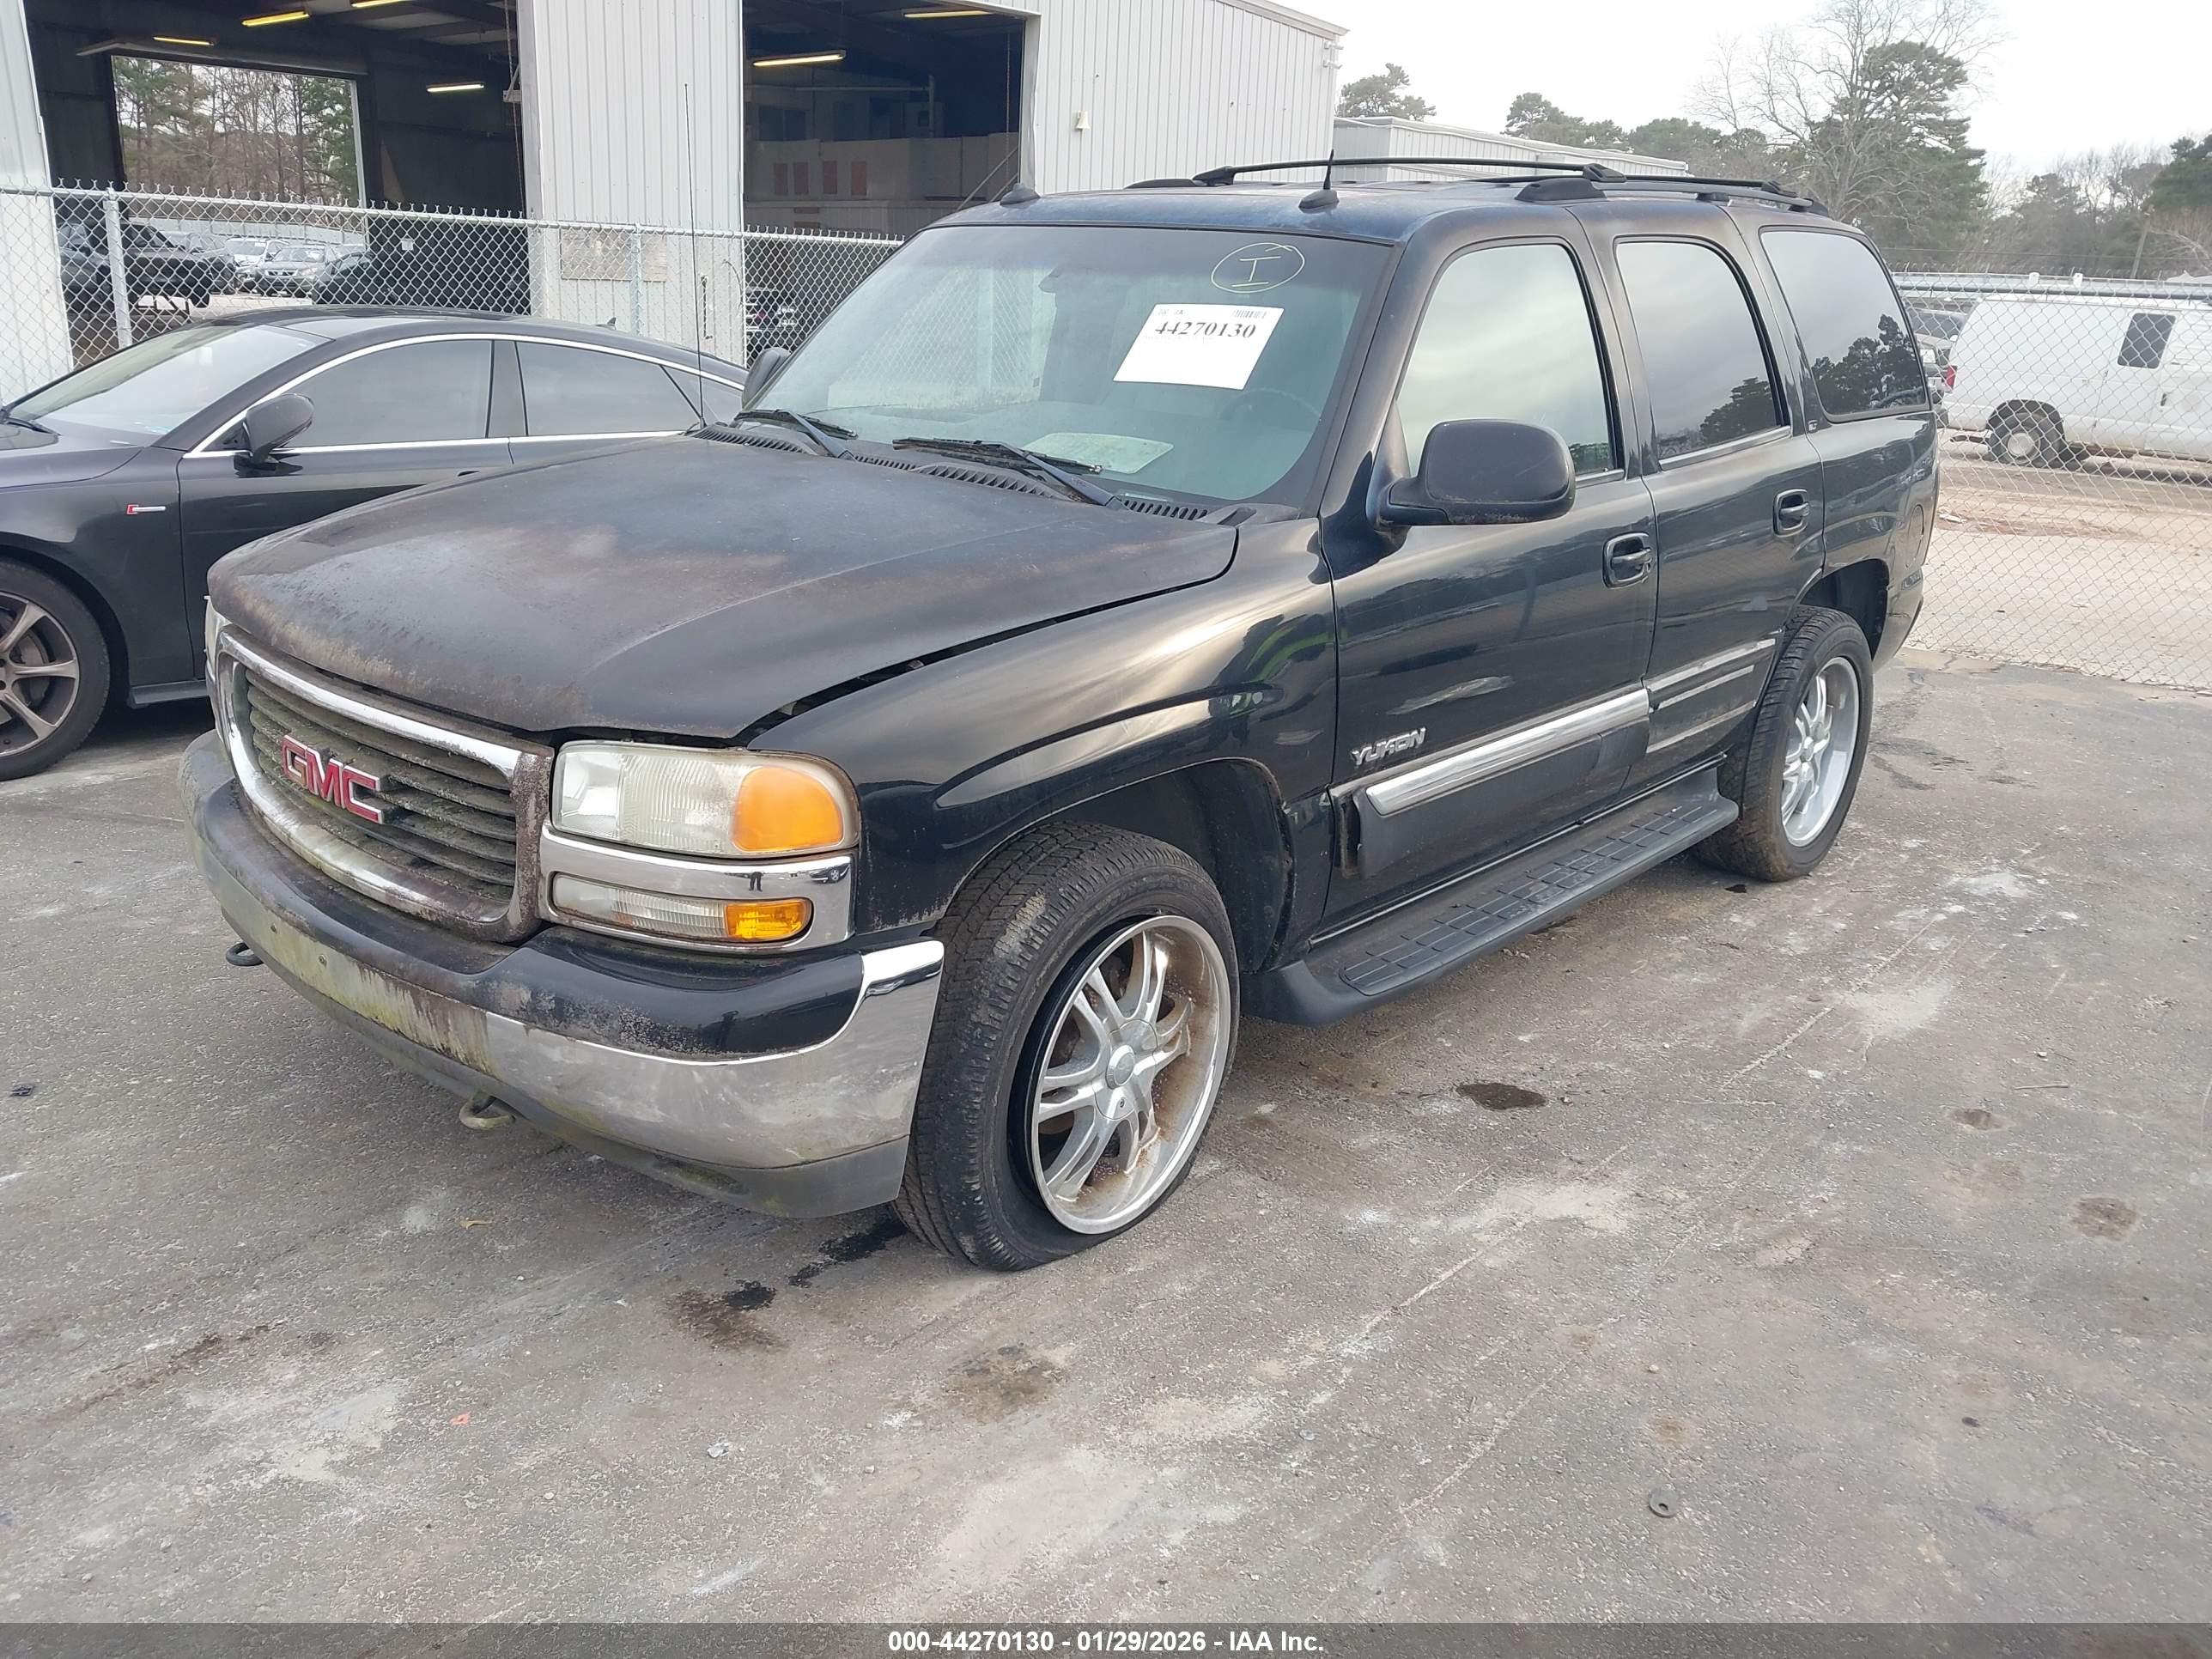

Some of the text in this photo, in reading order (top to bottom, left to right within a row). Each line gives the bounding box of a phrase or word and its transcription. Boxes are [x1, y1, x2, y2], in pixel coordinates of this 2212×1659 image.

[1155, 321, 1256, 338] 44270130
[1351, 726, 1426, 766] YUKON
[281, 734, 383, 824] GMC
